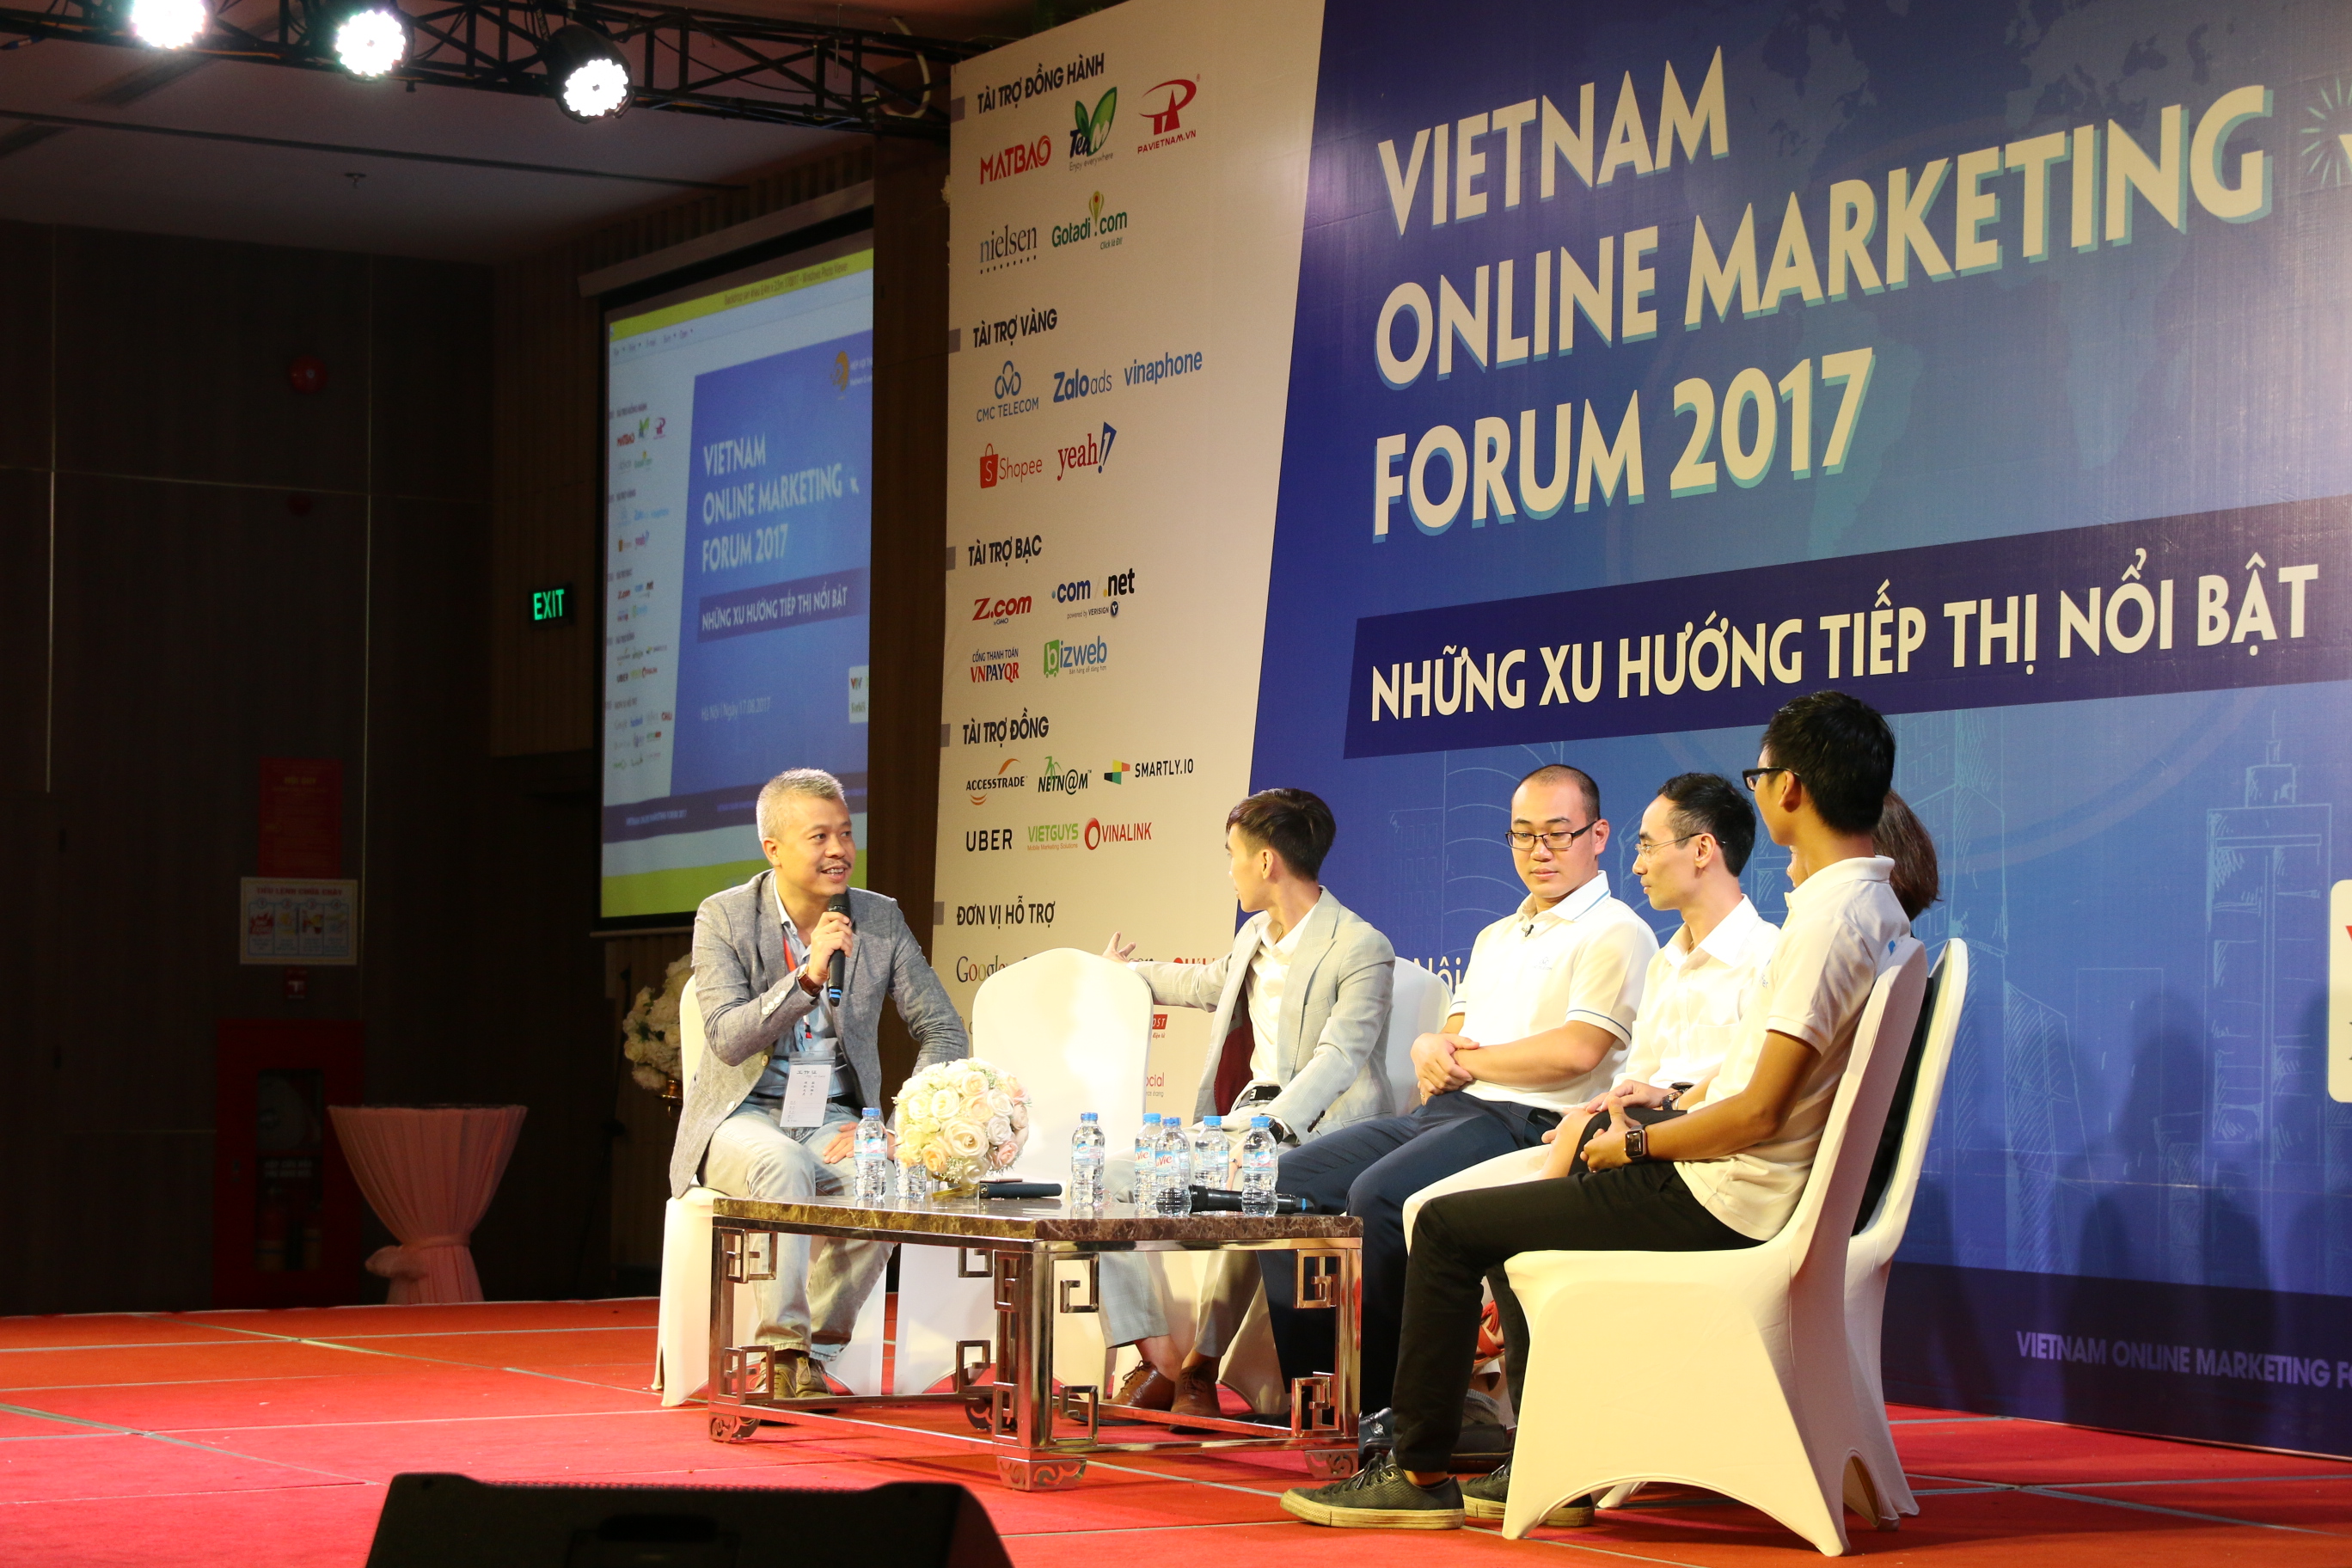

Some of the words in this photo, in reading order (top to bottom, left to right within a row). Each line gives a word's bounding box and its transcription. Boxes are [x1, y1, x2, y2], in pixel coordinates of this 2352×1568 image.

[977, 84, 995, 114] TÀI
[998, 76, 1023, 108] TRỢ
[1025, 63, 1063, 99] ĐỒNG
[1067, 52, 1105, 85] HÀNH
[980, 134, 1051, 185] MATBAO
[1377, 45, 1730, 241] VIETNAM
[979, 224, 1038, 264] nielsen
[1376, 226, 1658, 391] ONLINE
[1684, 84, 2274, 332] MARKETING
[973, 320, 991, 348] TÀI
[994, 315, 1018, 346] TRỢ
[1020, 307, 1057, 336] VÀNG
[1124, 351, 1203, 387] vinaphone
[977, 407, 995, 422] CMC
[998, 397, 1039, 418] TELECOM
[703, 432, 766, 477] VIETNAM
[1373, 389, 1645, 544] FORUM
[1669, 346, 1877, 500] 2017
[999, 456, 1043, 483] Shopee
[703, 482, 755, 526] ONLINE
[758, 462, 842, 514] MARKETING
[702, 531, 752, 573] FORUM
[756, 523, 788, 563] 2017
[969, 539, 986, 567] TÀI
[989, 536, 1013, 567] TRỢ
[1015, 535, 1042, 564] BẠC
[533, 589, 565, 621] EXIT
[702, 607, 731, 631] NHỮNG
[733, 604, 744, 627] XU
[746, 597, 778, 623] HƯỚNG
[780, 589, 796, 617] TIẾP
[798, 592, 812, 616] THỊ
[972, 595, 1032, 621] Z.com
[1067, 610, 1082, 620] powered
[1088, 606, 1109, 616] VERISIGN
[1044, 635, 1107, 671] bizweb
[1372, 644, 1526, 722] NHỮNG
[1539, 640, 1603, 707] XU
[1619, 610, 1803, 699] HƯỚNG
[1819, 579, 1926, 679] TIẾP
[1944, 593, 2037, 676] THỊ
[2060, 548, 2173, 659] NỔI
[2196, 551, 2319, 657] BẬT
[971, 662, 1020, 683] VNPAYQR
[972, 649, 985, 663] CỔNG
[987, 650, 1004, 661] THANH
[1005, 646, 1019, 659] TOÁN
[963, 718, 981, 745] TÀI
[983, 717, 1008, 748] TRỢ
[1010, 707, 1050, 741] ĐỒNG
[966, 776, 1025, 791] ACCESSTRADE
[1135, 758, 1194, 778] SMARTLY.IO
[966, 829, 1013, 852] UBER
[1028, 823, 1079, 842] VIETGUYS
[957, 903, 985, 926] ĐƠN
[989, 903, 1001, 929] VỊ
[1005, 896, 1026, 925] HỖ
[1028, 901, 1056, 928] TRỢ
[2017, 1330, 2107, 1365] VIETNAM
[2112, 1339, 2190, 1374] ONLINE
[2196, 1348, 2331, 1387] MARKETING
